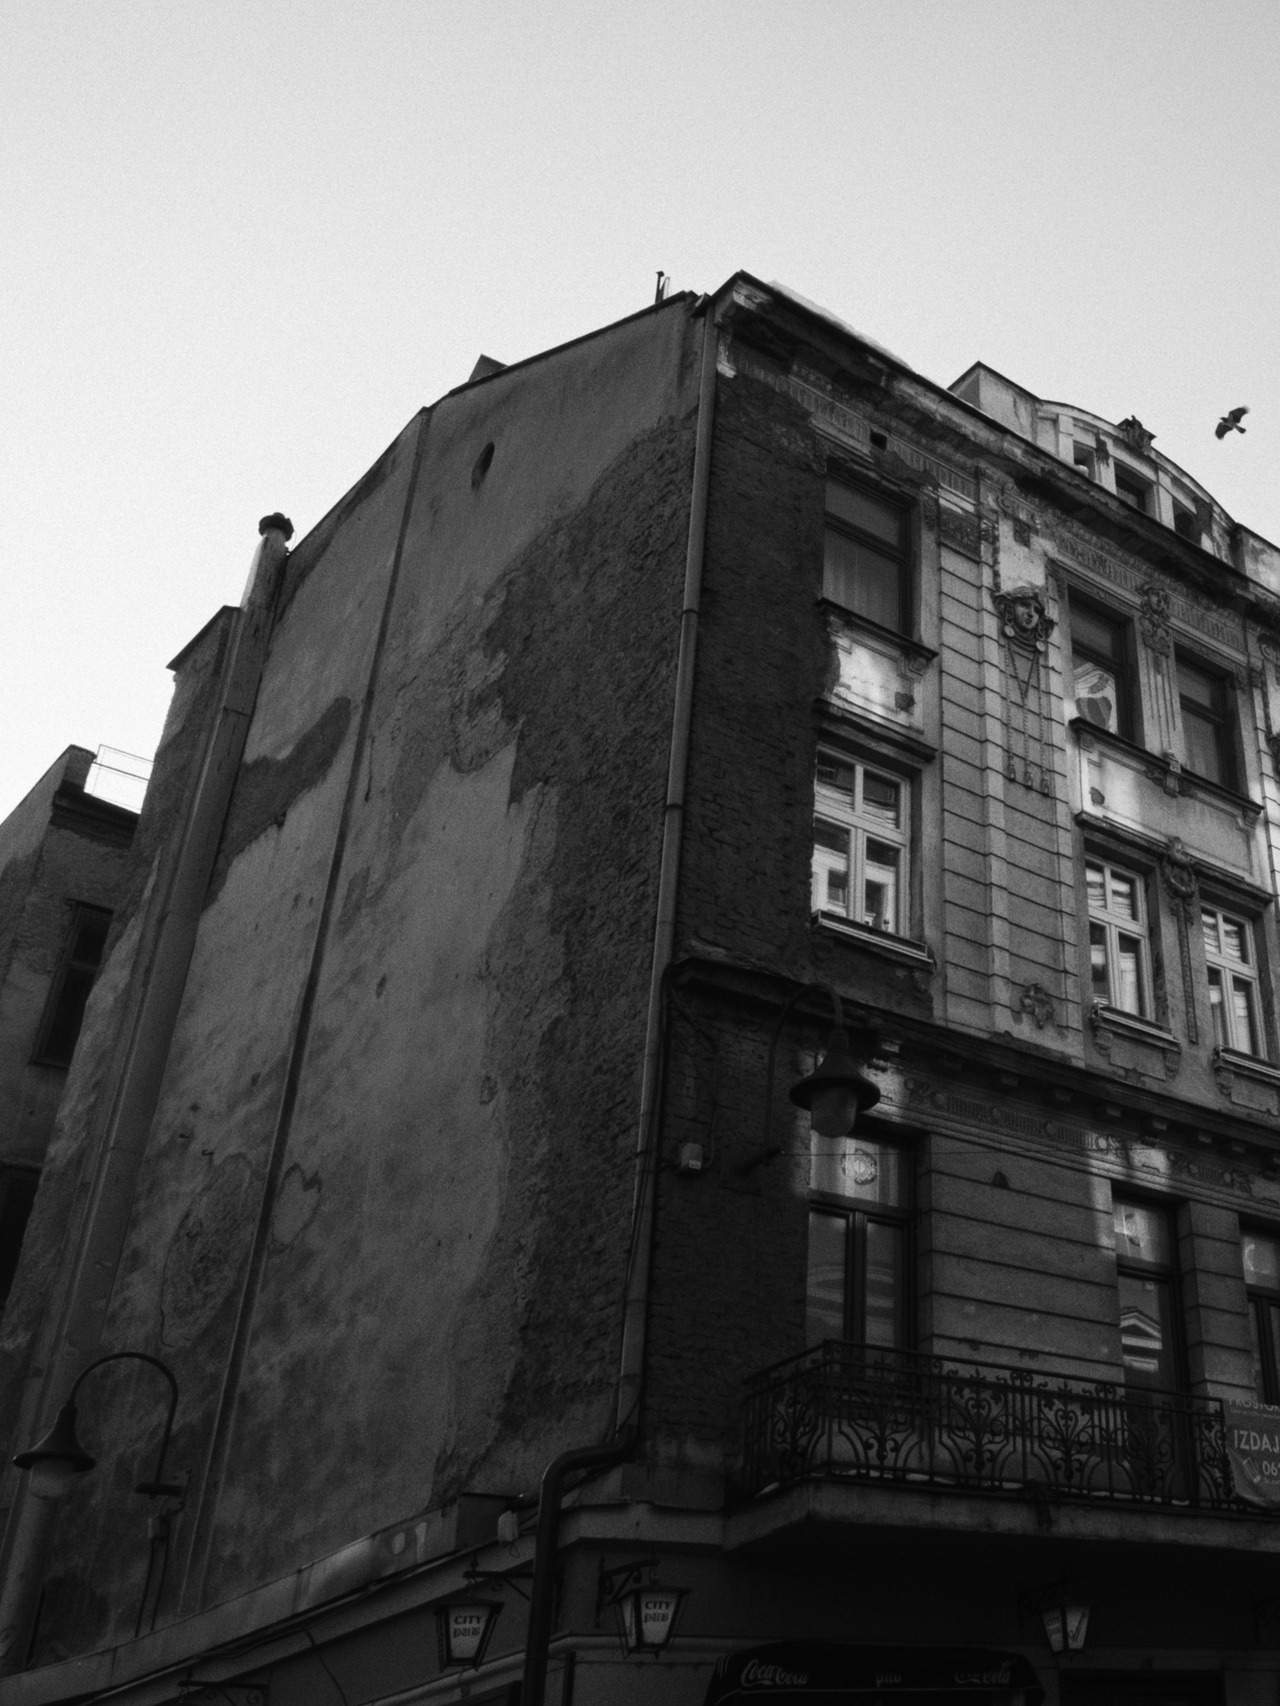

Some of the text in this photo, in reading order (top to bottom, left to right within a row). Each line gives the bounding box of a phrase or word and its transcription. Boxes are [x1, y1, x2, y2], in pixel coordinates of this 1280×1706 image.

[645, 1600, 673, 1610] CITY
[454, 1615, 483, 1625] CITY
[1046, 1616, 1060, 1627] CITY
